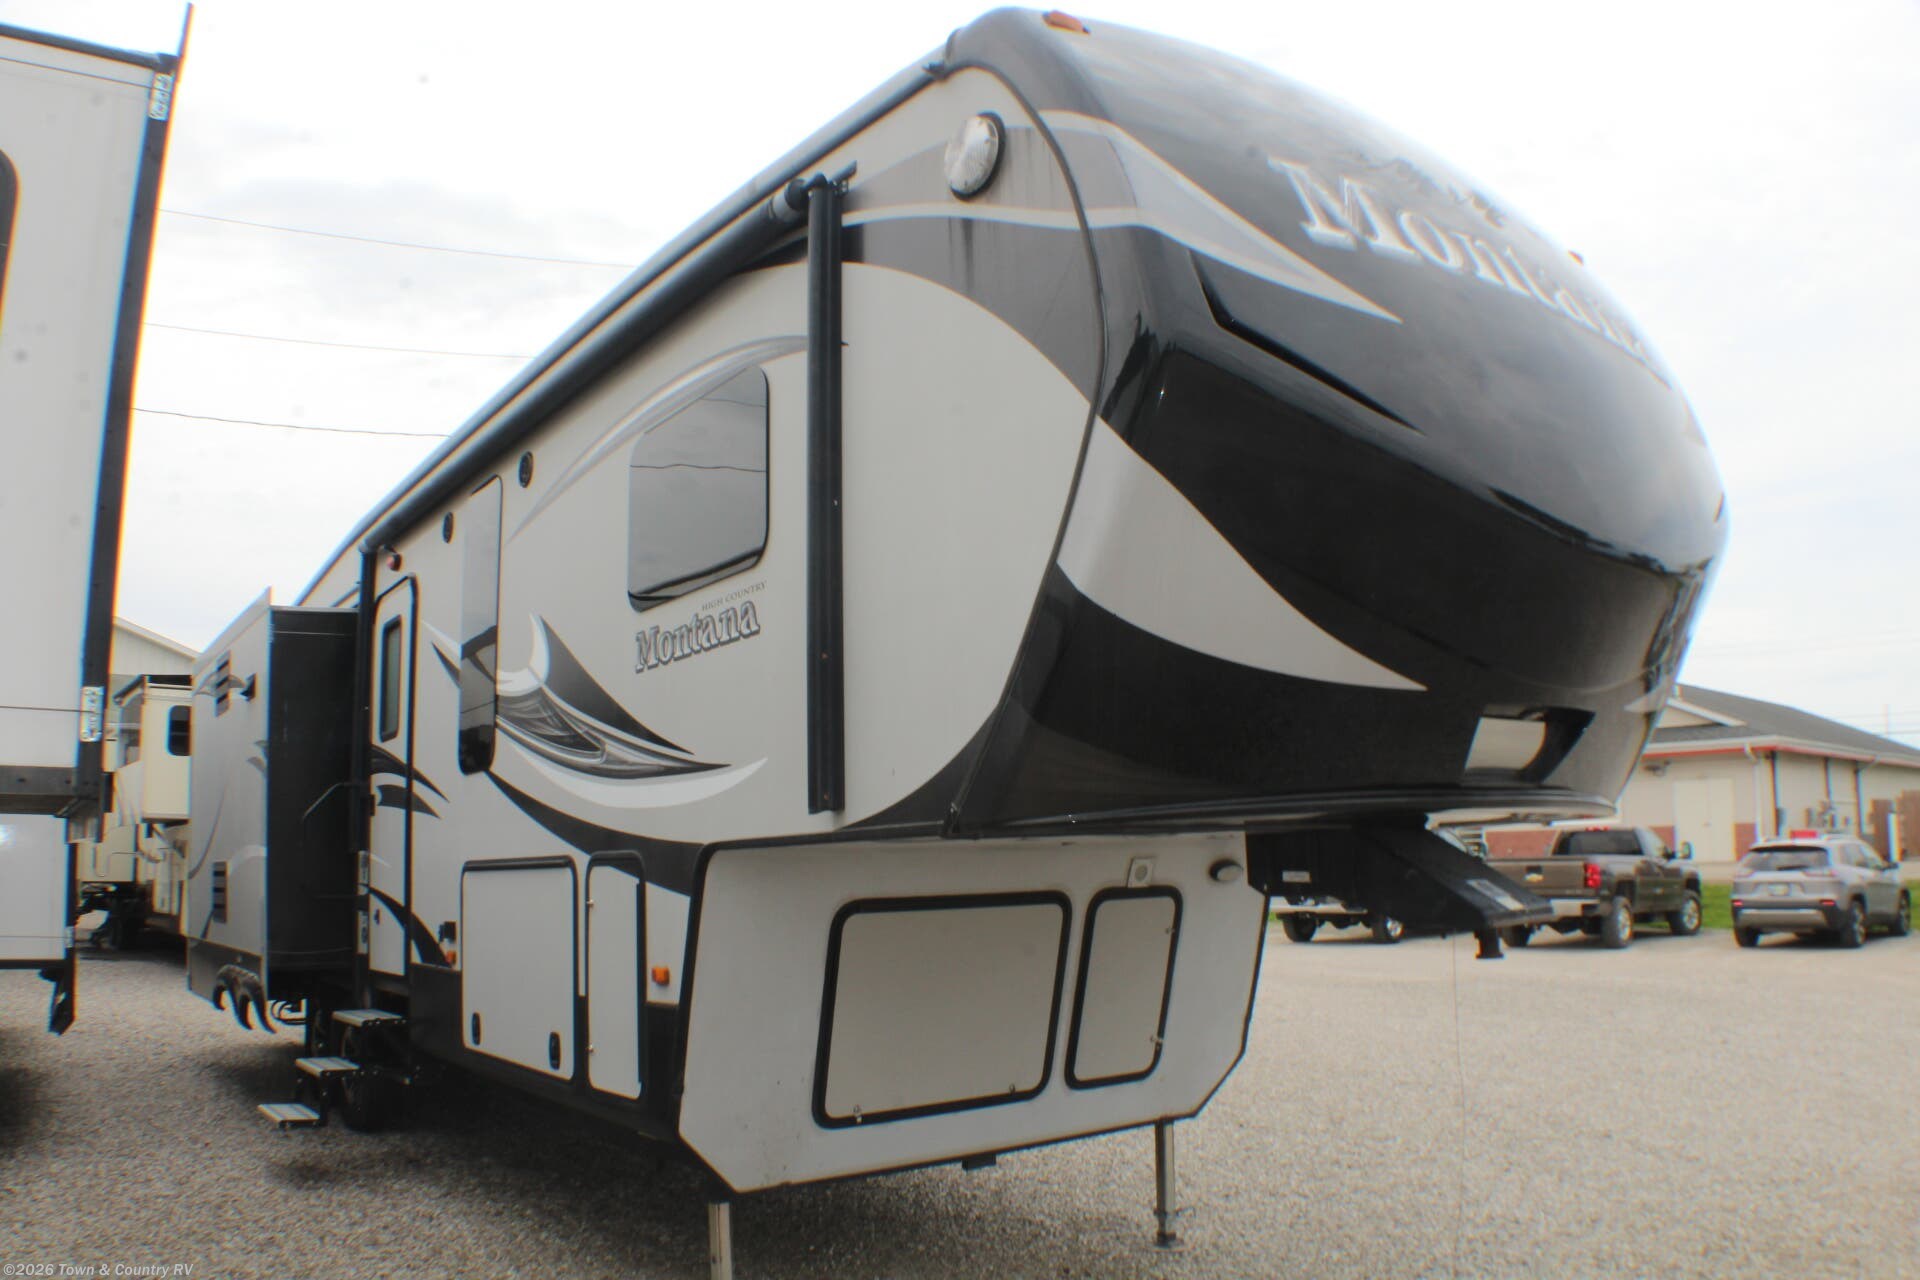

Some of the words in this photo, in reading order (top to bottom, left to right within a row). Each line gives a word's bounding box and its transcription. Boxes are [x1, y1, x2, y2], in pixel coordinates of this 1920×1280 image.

[701, 597, 724, 612] HIGH
[725, 580, 767, 603] COUNTRY
[635, 599, 761, 674] Montana
